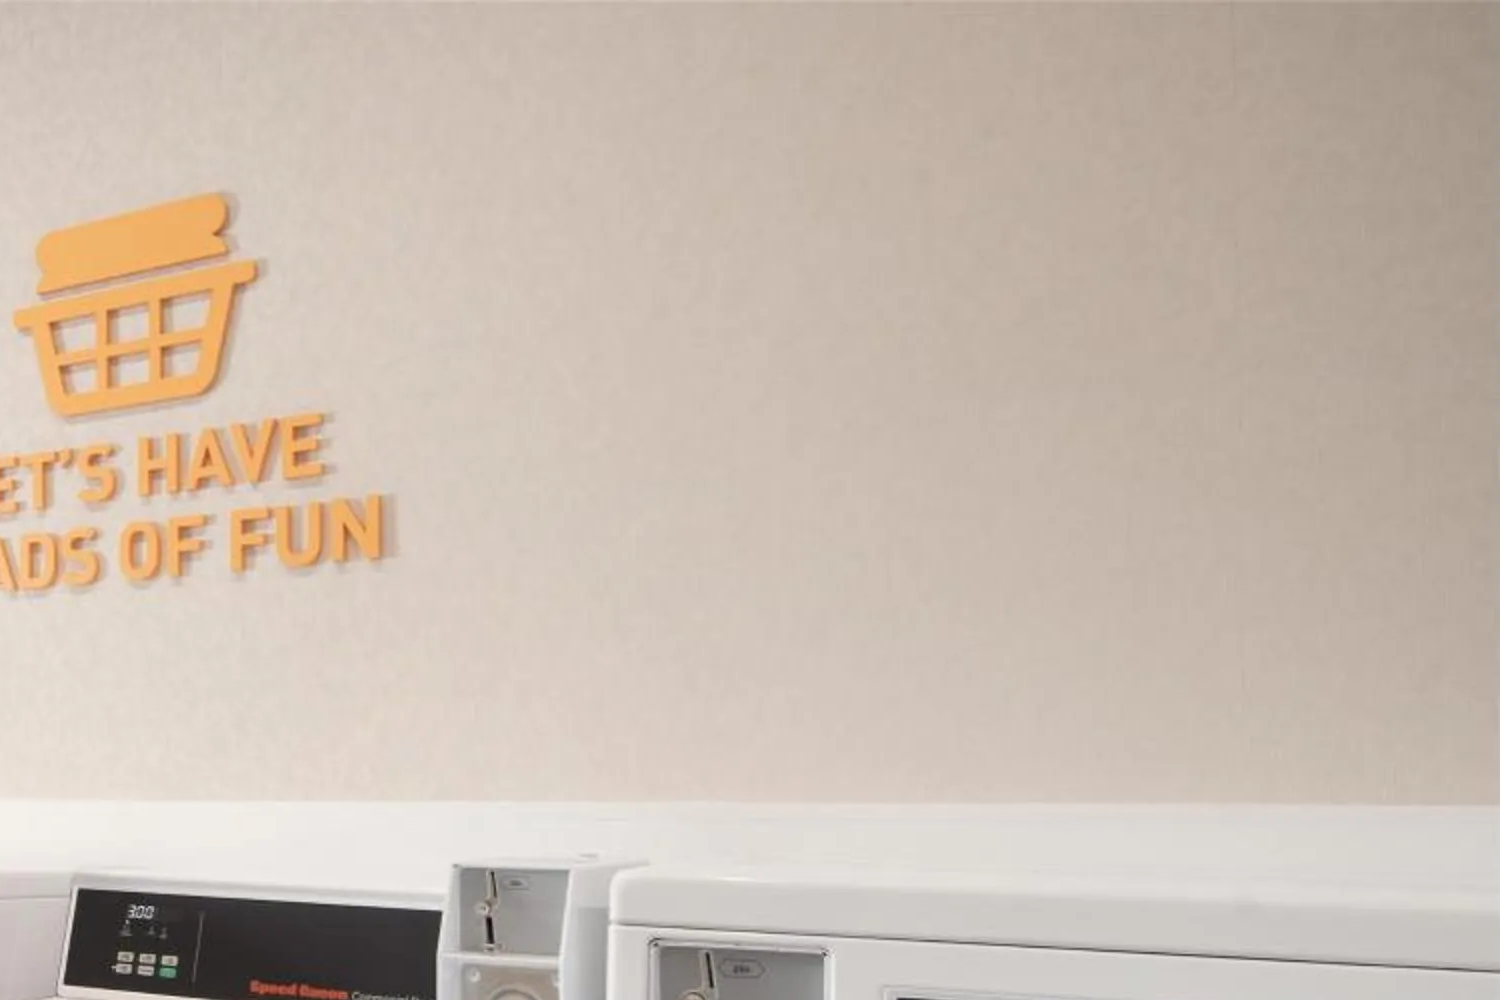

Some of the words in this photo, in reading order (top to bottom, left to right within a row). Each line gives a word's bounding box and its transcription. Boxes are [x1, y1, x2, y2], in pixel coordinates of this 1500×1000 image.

[137, 411, 326, 497] HAVE
[119, 514, 210, 582] OF
[229, 494, 384, 574] FUN
